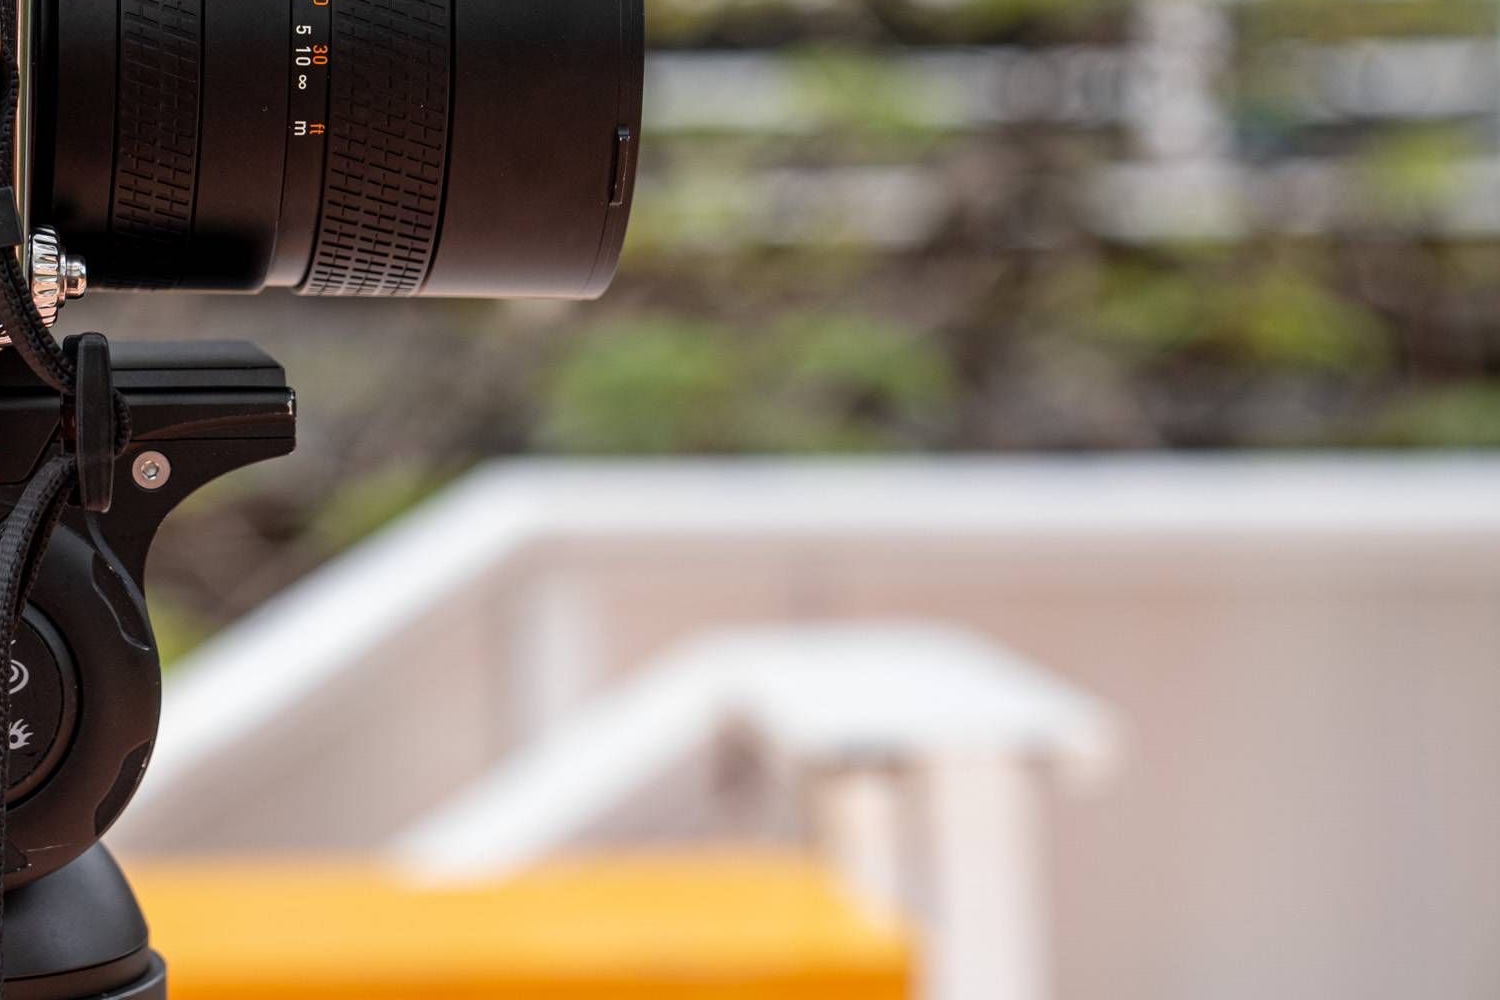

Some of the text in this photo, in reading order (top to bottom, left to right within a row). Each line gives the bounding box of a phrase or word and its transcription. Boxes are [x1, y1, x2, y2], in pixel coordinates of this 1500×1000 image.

[296, 25, 311, 35] 5
[295, 46, 311, 66] 10
[312, 45, 328, 65] 30
[294, 120, 307, 135] m
[309, 123, 325, 135] ft
